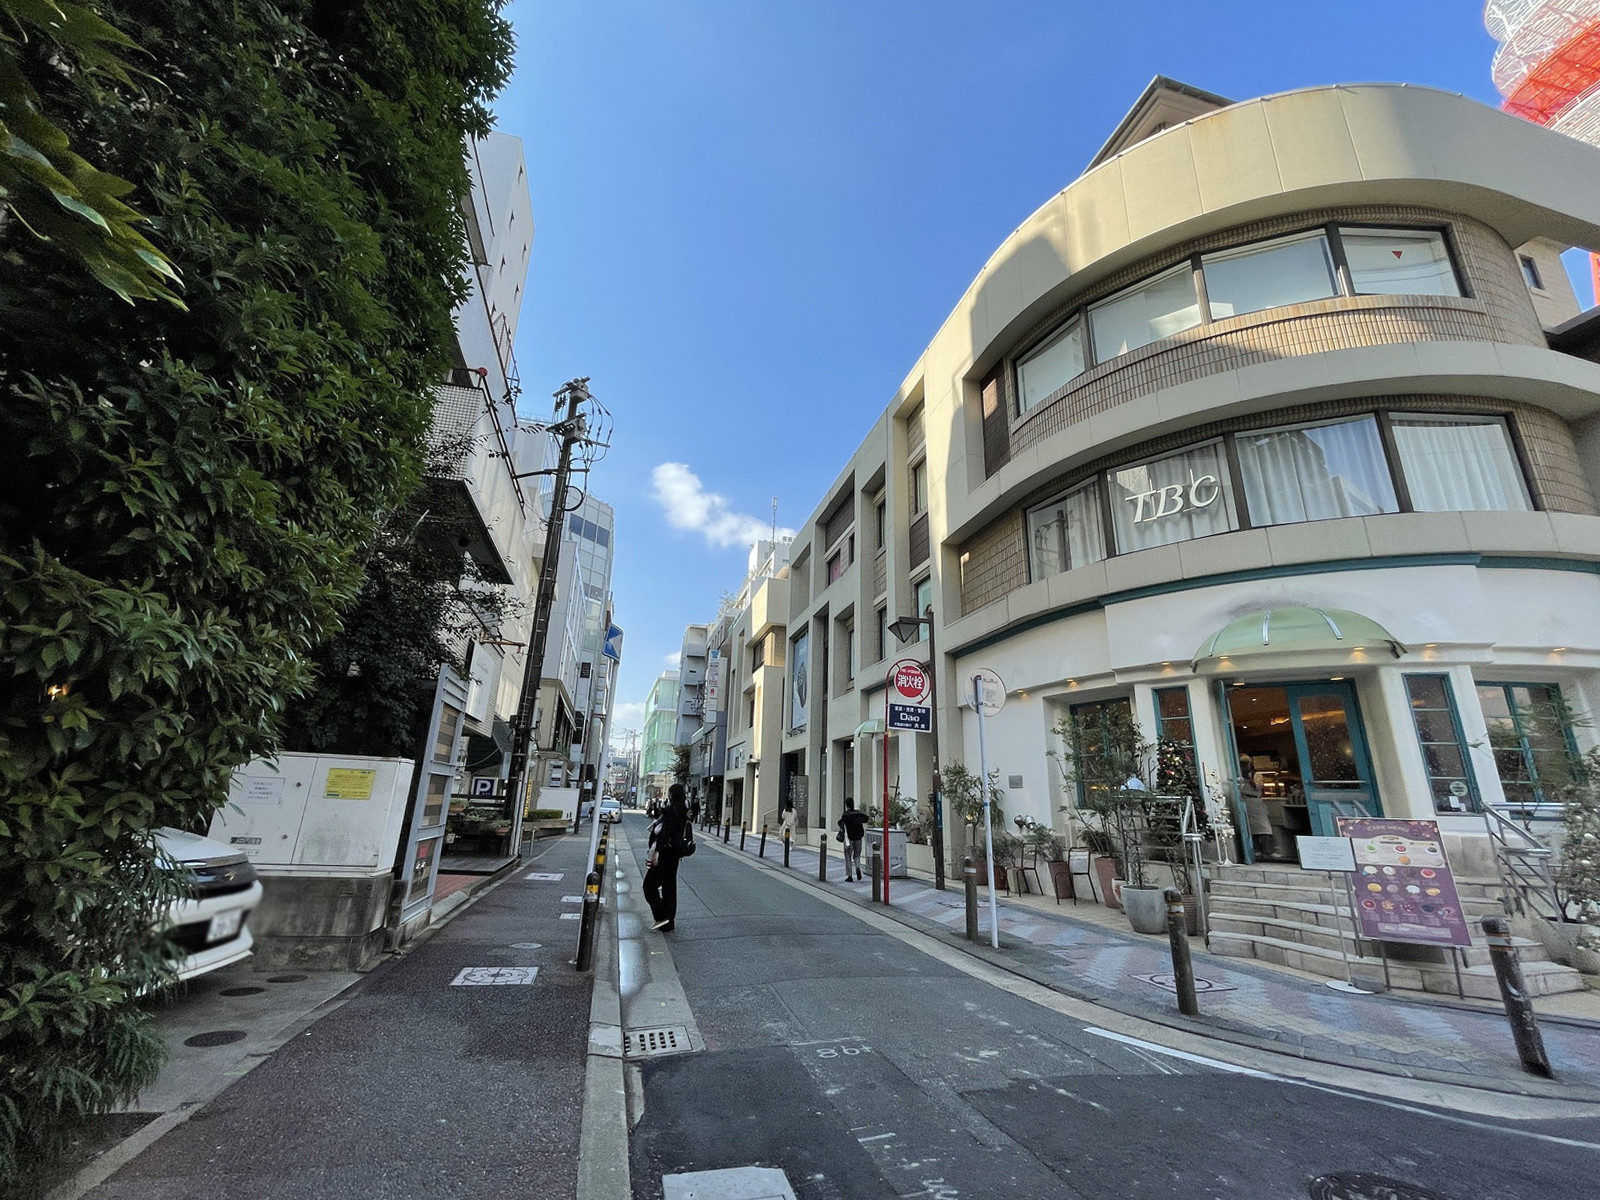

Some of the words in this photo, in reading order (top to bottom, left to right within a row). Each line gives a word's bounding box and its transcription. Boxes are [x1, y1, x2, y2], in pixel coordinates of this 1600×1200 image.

[1124, 474, 1219, 523] TBC
[897, 673, 923, 690] 消火栓
[475, 780, 491, 795] P
